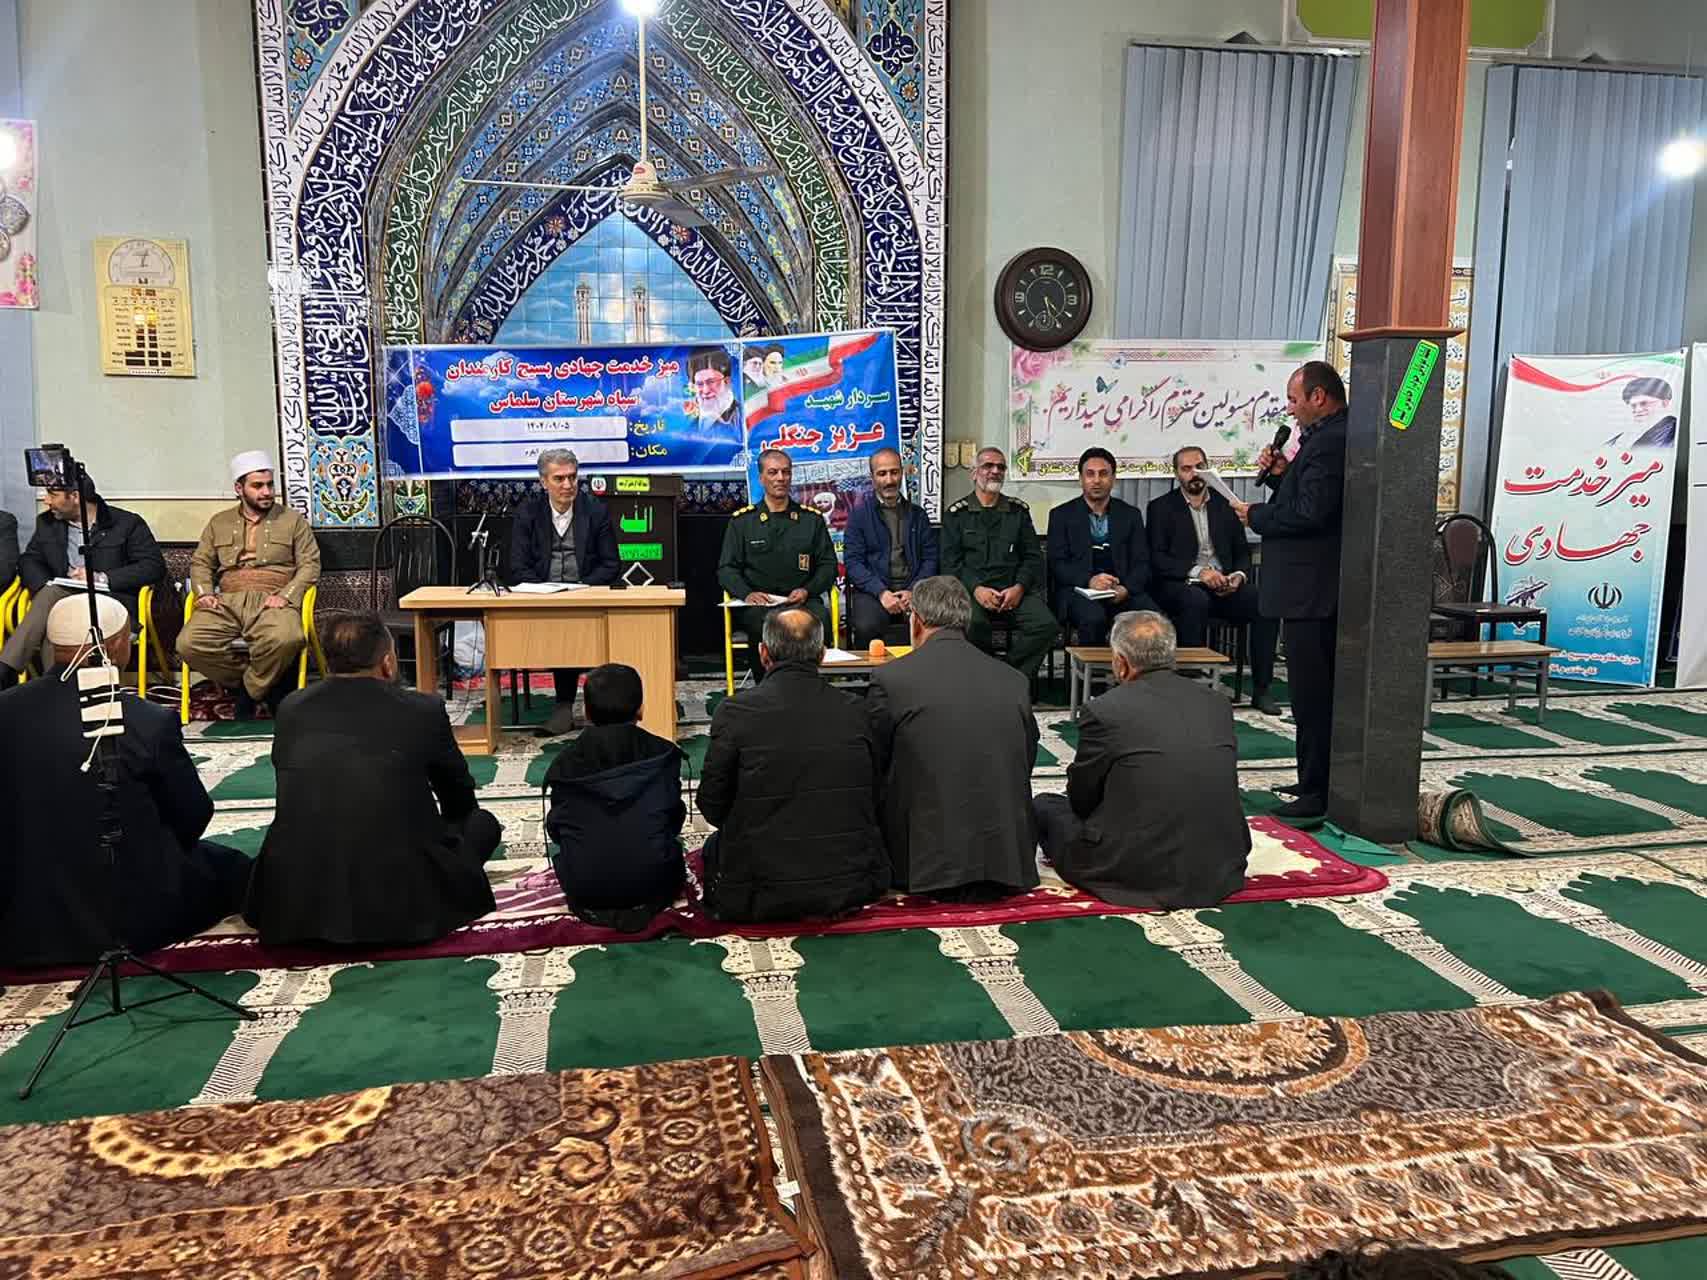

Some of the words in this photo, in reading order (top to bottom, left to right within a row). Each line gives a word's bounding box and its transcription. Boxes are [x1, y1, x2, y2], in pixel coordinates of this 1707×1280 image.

[1040, 264, 1054, 276] 12
[447, 359, 512, 381] کارمندان
[517, 361, 552, 379] بسیج
[555, 357, 604, 379] جهادی
[607, 355, 653, 374] خدمت
[656, 358, 679, 378] میز
[489, 392, 540, 413] سلماس
[542, 390, 605, 411] شهرستان
[805, 389, 844, 410] شهید
[845, 387, 890, 409] سردار
[828, 422, 885, 453] عزیز
[1503, 456, 1611, 496] خدمت
[1596, 452, 1663, 507] میز
[1503, 520, 1652, 566] جهادی
